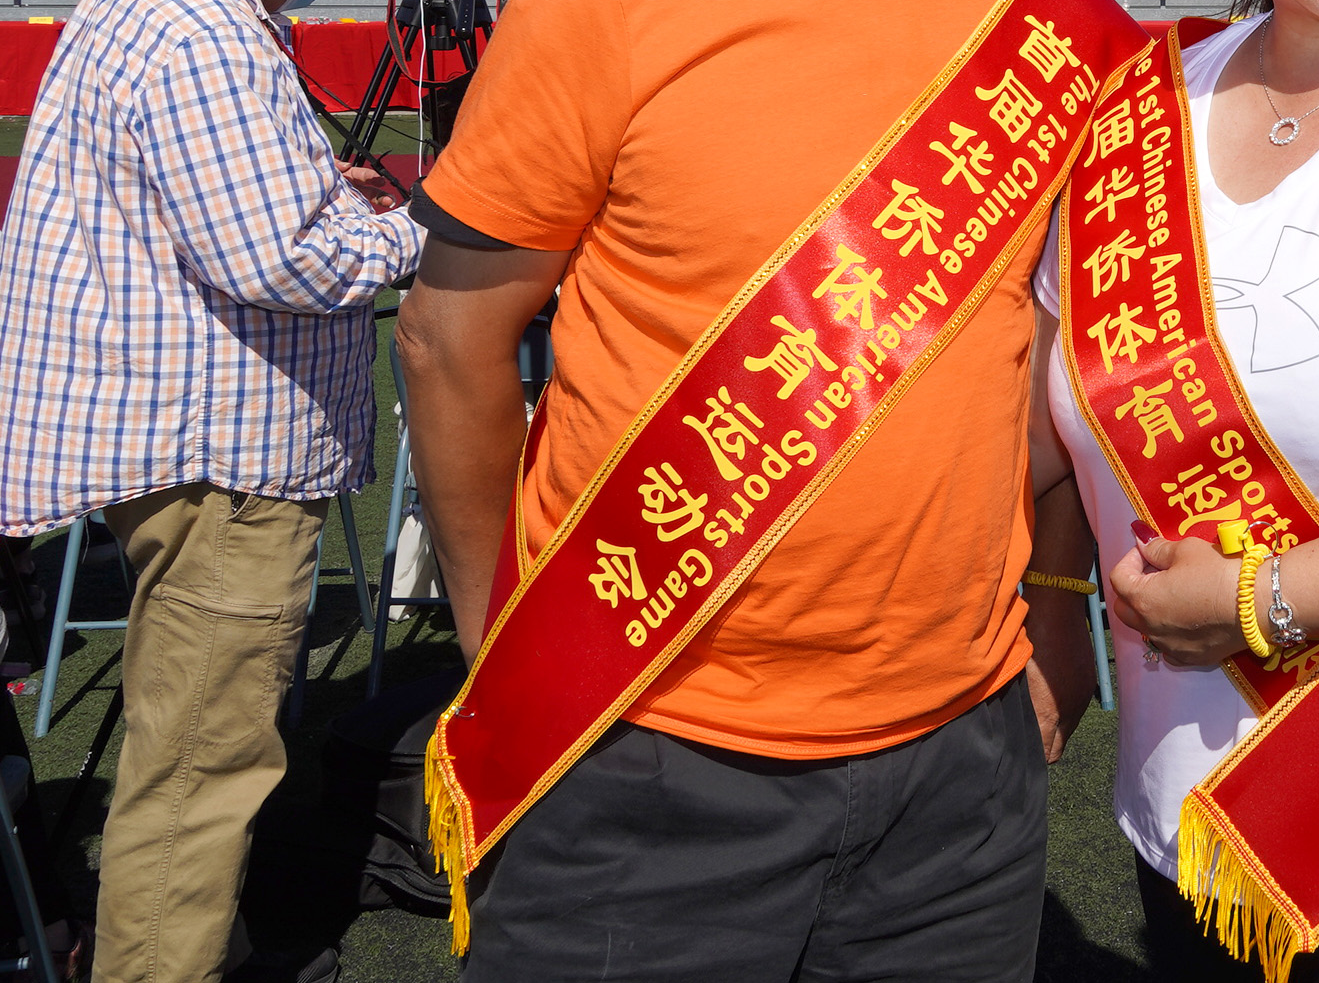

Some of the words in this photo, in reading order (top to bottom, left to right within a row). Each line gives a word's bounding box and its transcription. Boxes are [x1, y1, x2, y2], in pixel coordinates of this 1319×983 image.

[1027, 114, 1068, 164] 1st
[1061, 63, 1101, 115] The
[1135, 75, 1166, 129] 1st
[939, 156, 1038, 274] Chinese
[1141, 125, 1173, 248] Chinese
[804, 269, 949, 430] American
[1083, 73, 1242, 537] 届华侨体育运
[1149, 252, 1218, 428] American
[703, 429, 818, 548] Sports
[1210, 429, 1300, 555] Sports
[625, 548, 714, 648] Game
